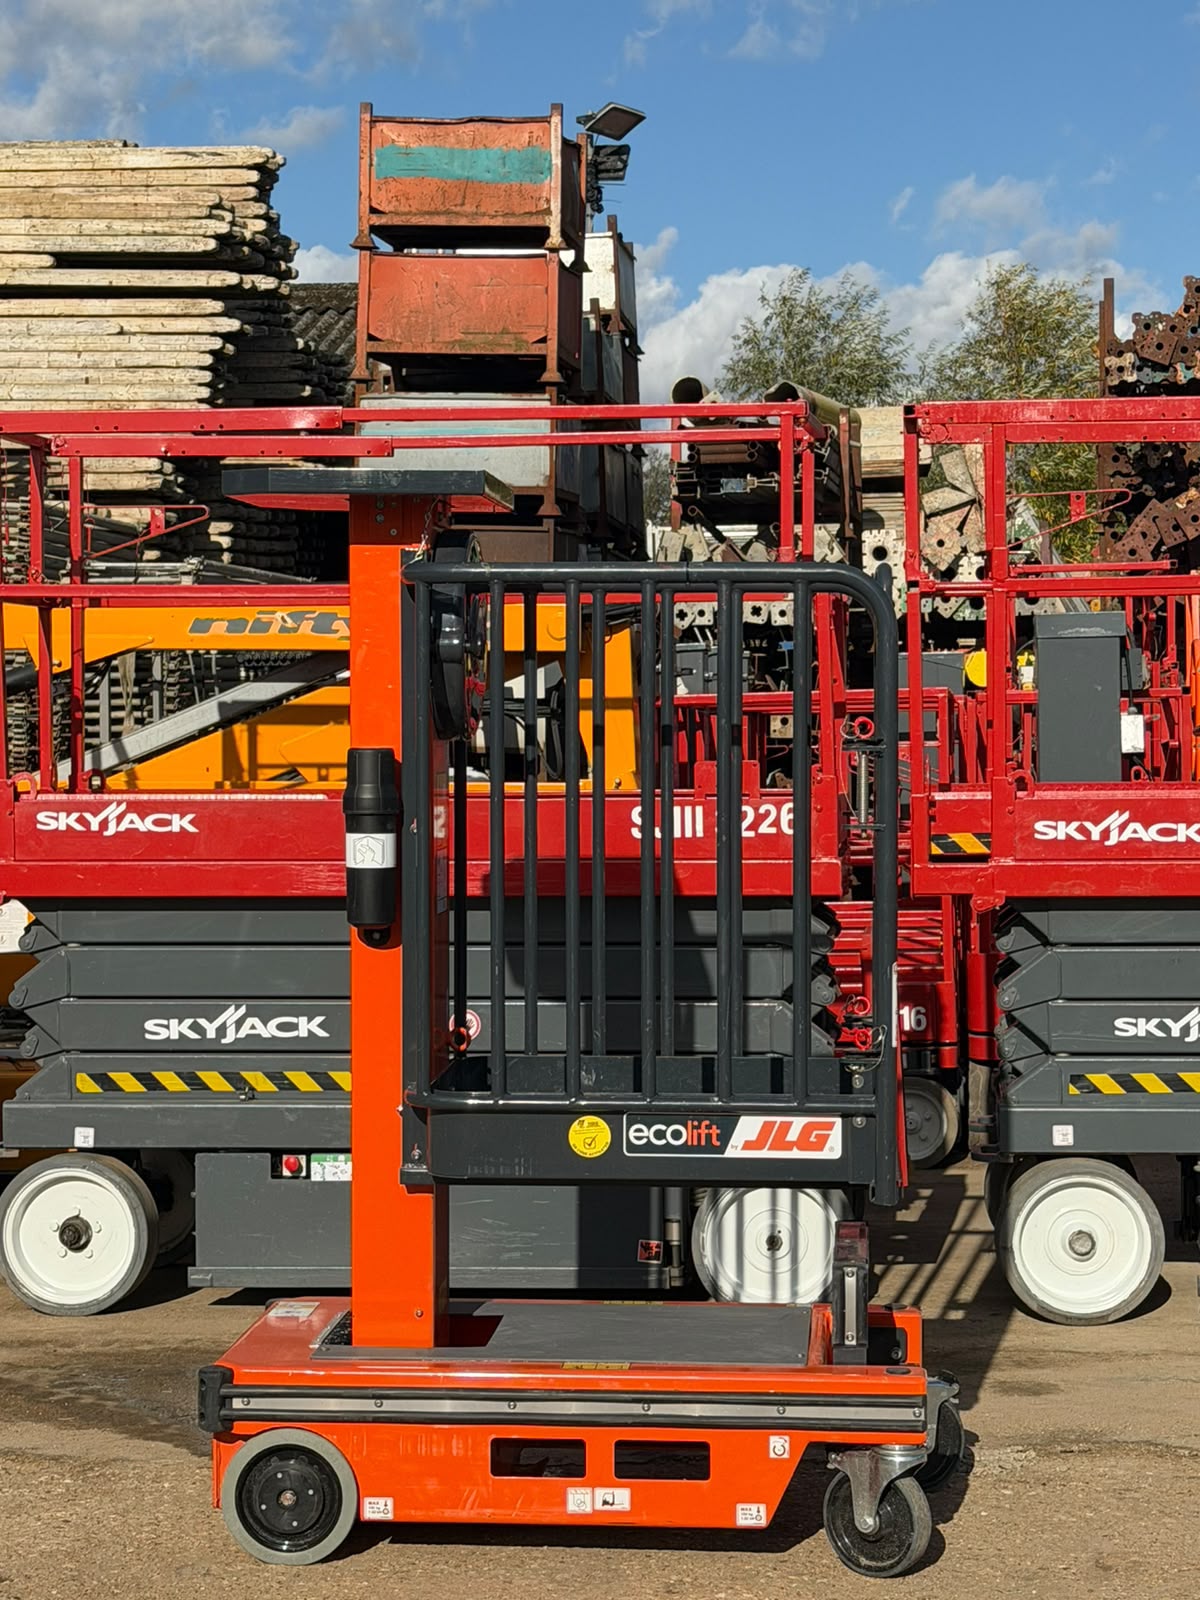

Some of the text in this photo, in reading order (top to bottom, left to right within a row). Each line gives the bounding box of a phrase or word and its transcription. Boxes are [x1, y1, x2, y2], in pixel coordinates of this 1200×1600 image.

[36, 801, 199, 837] SKYJACK
[1033, 811, 1200, 846] SKYJACK
[143, 1003, 329, 1043] SKYJACK
[898, 1005, 927, 1032] 16
[1113, 1007, 1200, 1043] SKYJ
[628, 1120, 720, 1147] ecolift
[741, 1121, 836, 1152] JLG
